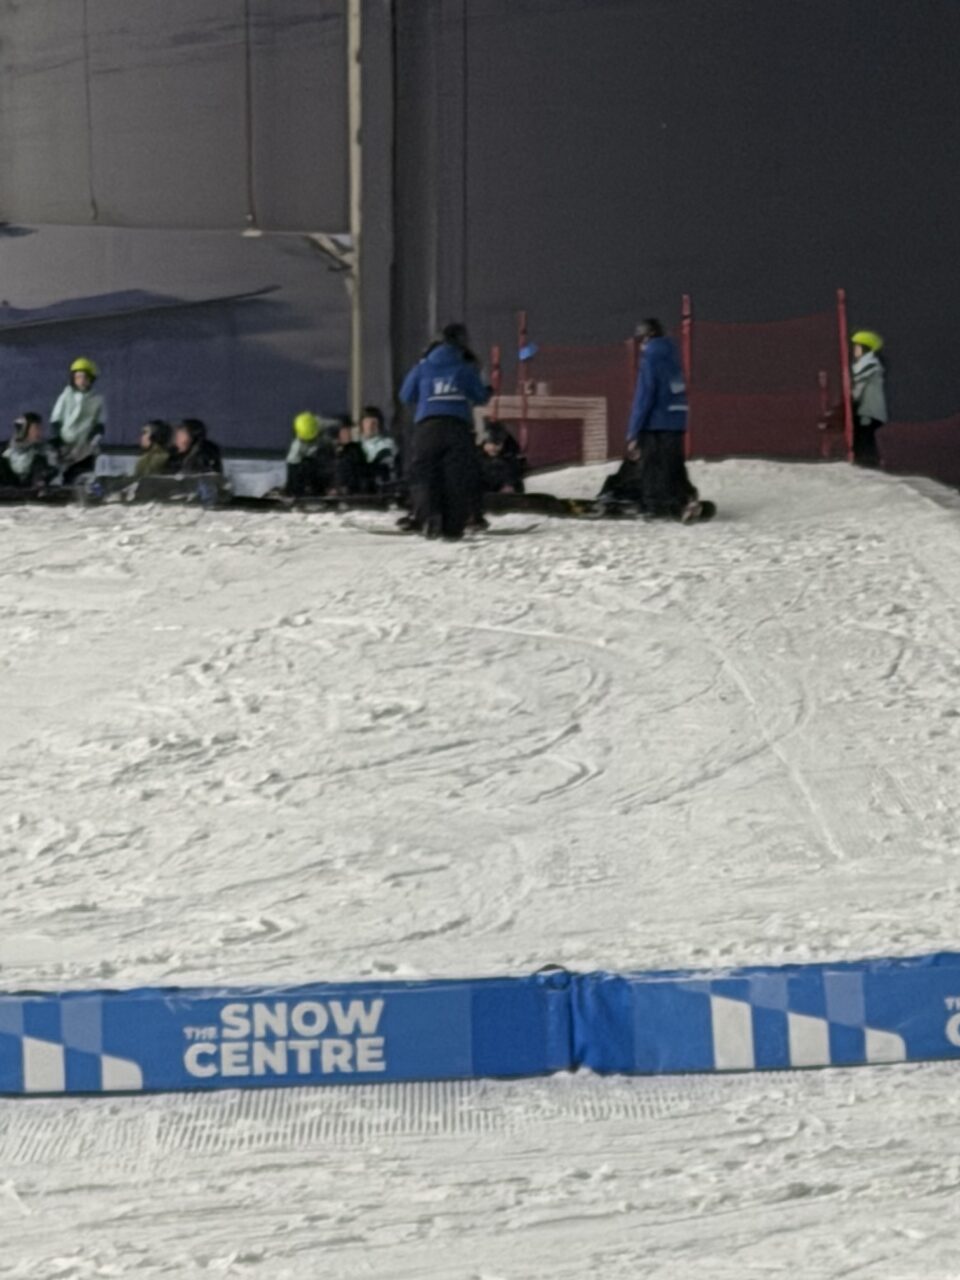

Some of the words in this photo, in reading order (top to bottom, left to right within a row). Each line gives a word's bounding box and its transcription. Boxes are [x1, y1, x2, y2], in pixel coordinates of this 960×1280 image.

[183, 1026, 218, 1041] THE
[220, 999, 384, 1039] SNOW
[183, 1036, 386, 1077] CENTRE
